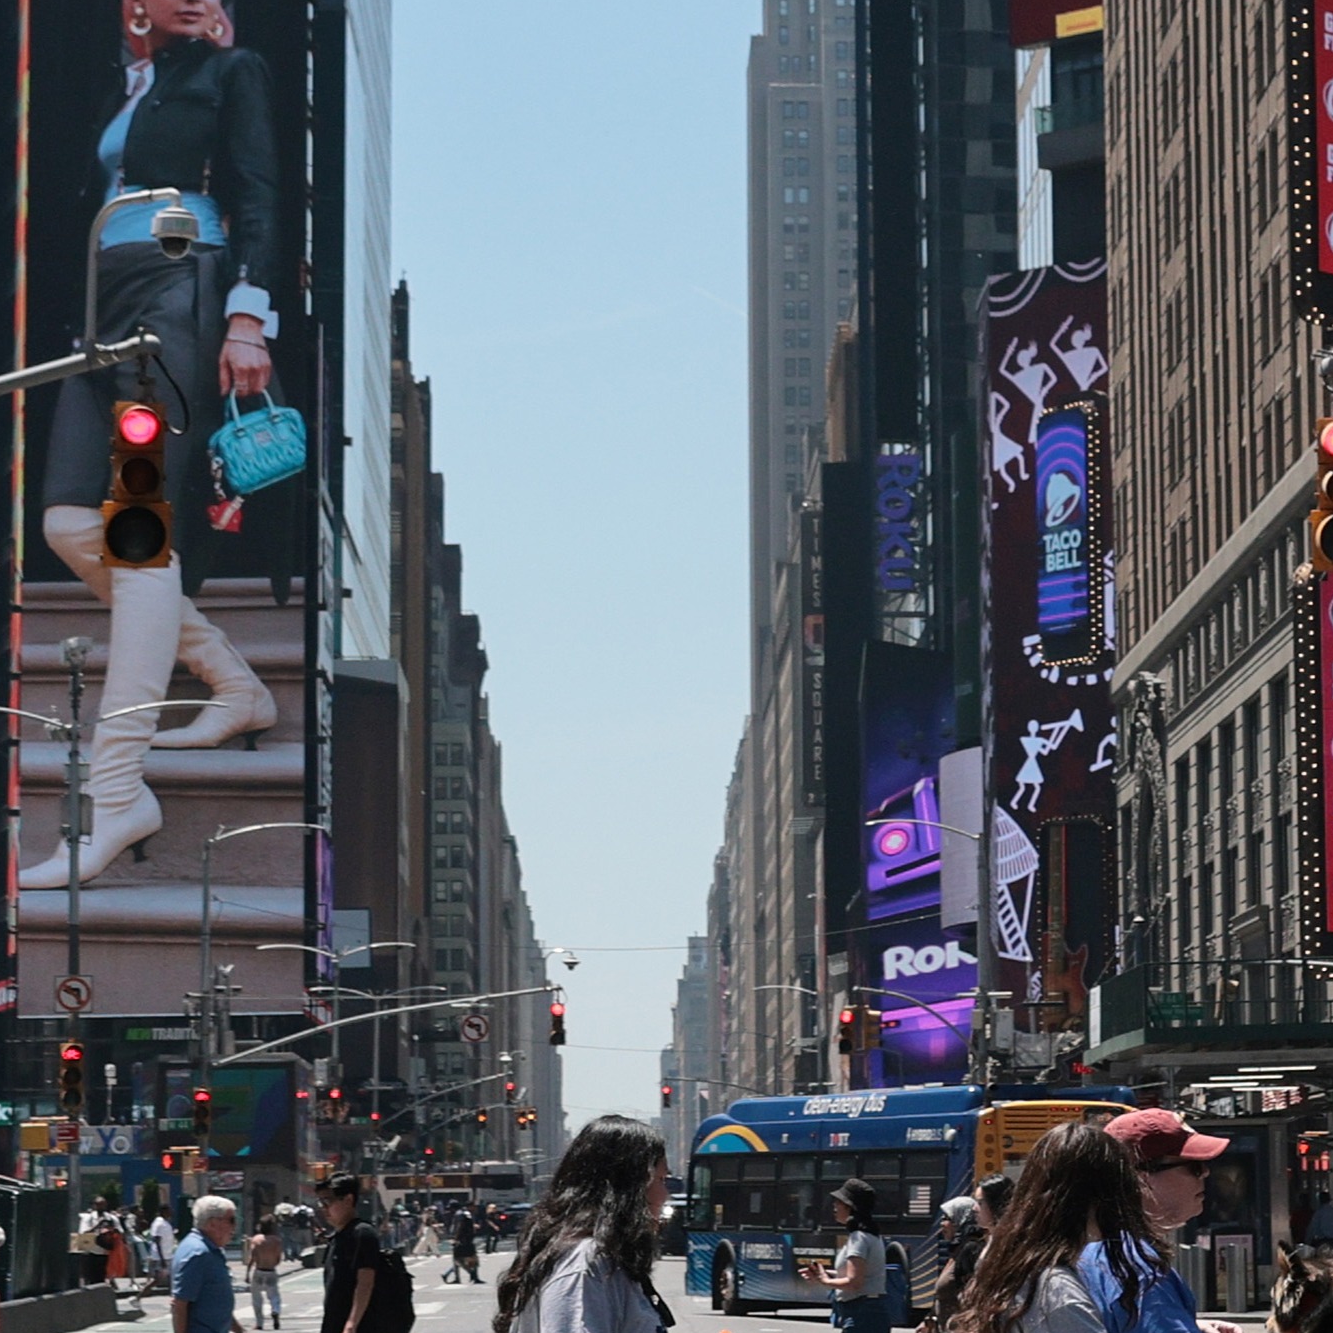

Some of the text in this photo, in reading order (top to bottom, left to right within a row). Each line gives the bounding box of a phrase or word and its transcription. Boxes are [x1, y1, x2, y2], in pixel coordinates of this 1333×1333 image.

[1042, 528, 1082, 554] TACO
[1045, 548, 1083, 573] BELL
[802, 1093, 887, 1118] clean-energy bus
